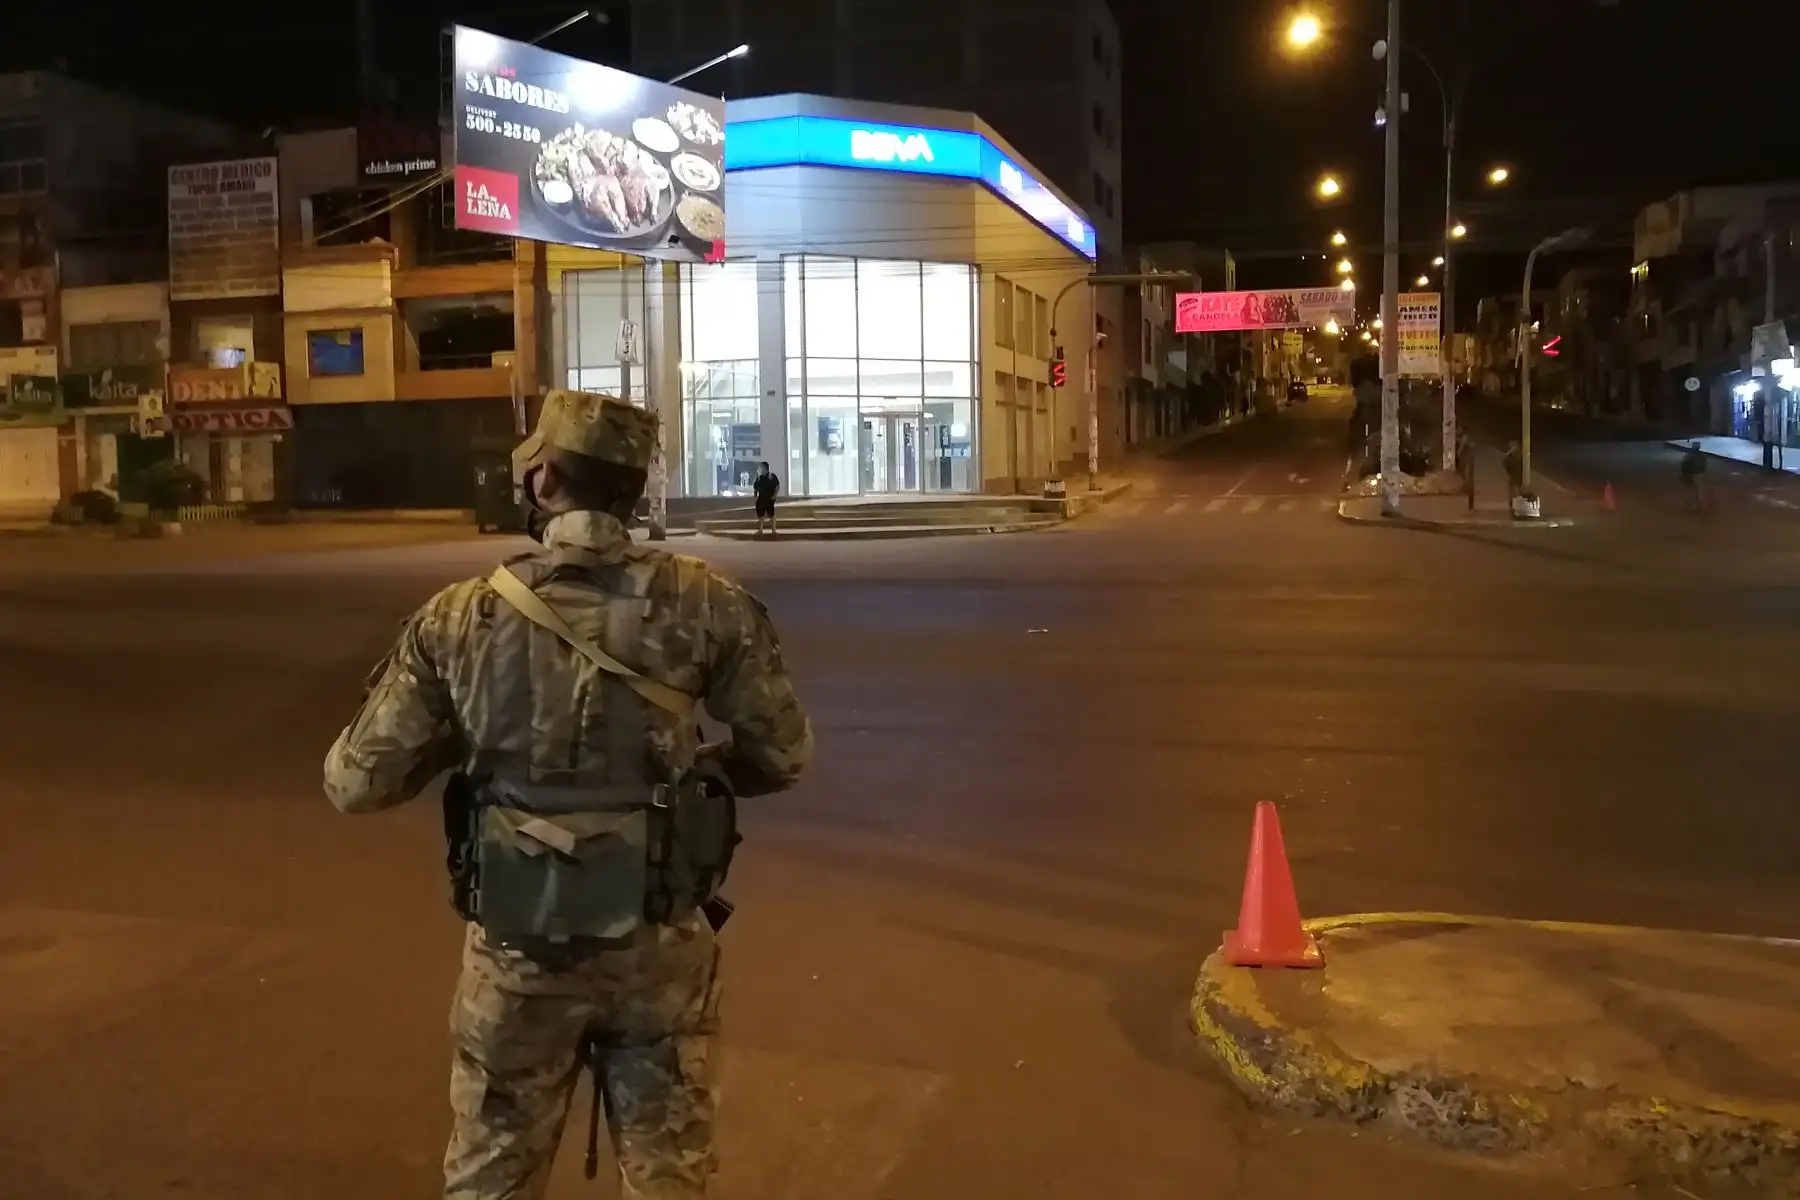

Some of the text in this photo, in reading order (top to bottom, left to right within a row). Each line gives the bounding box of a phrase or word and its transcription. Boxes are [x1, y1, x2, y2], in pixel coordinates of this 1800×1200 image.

[465, 71, 570, 114] SABORES
[465, 104, 497, 119] DELIVERY
[365, 158, 436, 176] chicken prime
[467, 180, 490, 200] LA
[1192, 311, 1241, 322] CANDELA
[172, 379, 242, 402] DENT
[171, 409, 292, 431] OPTICA
